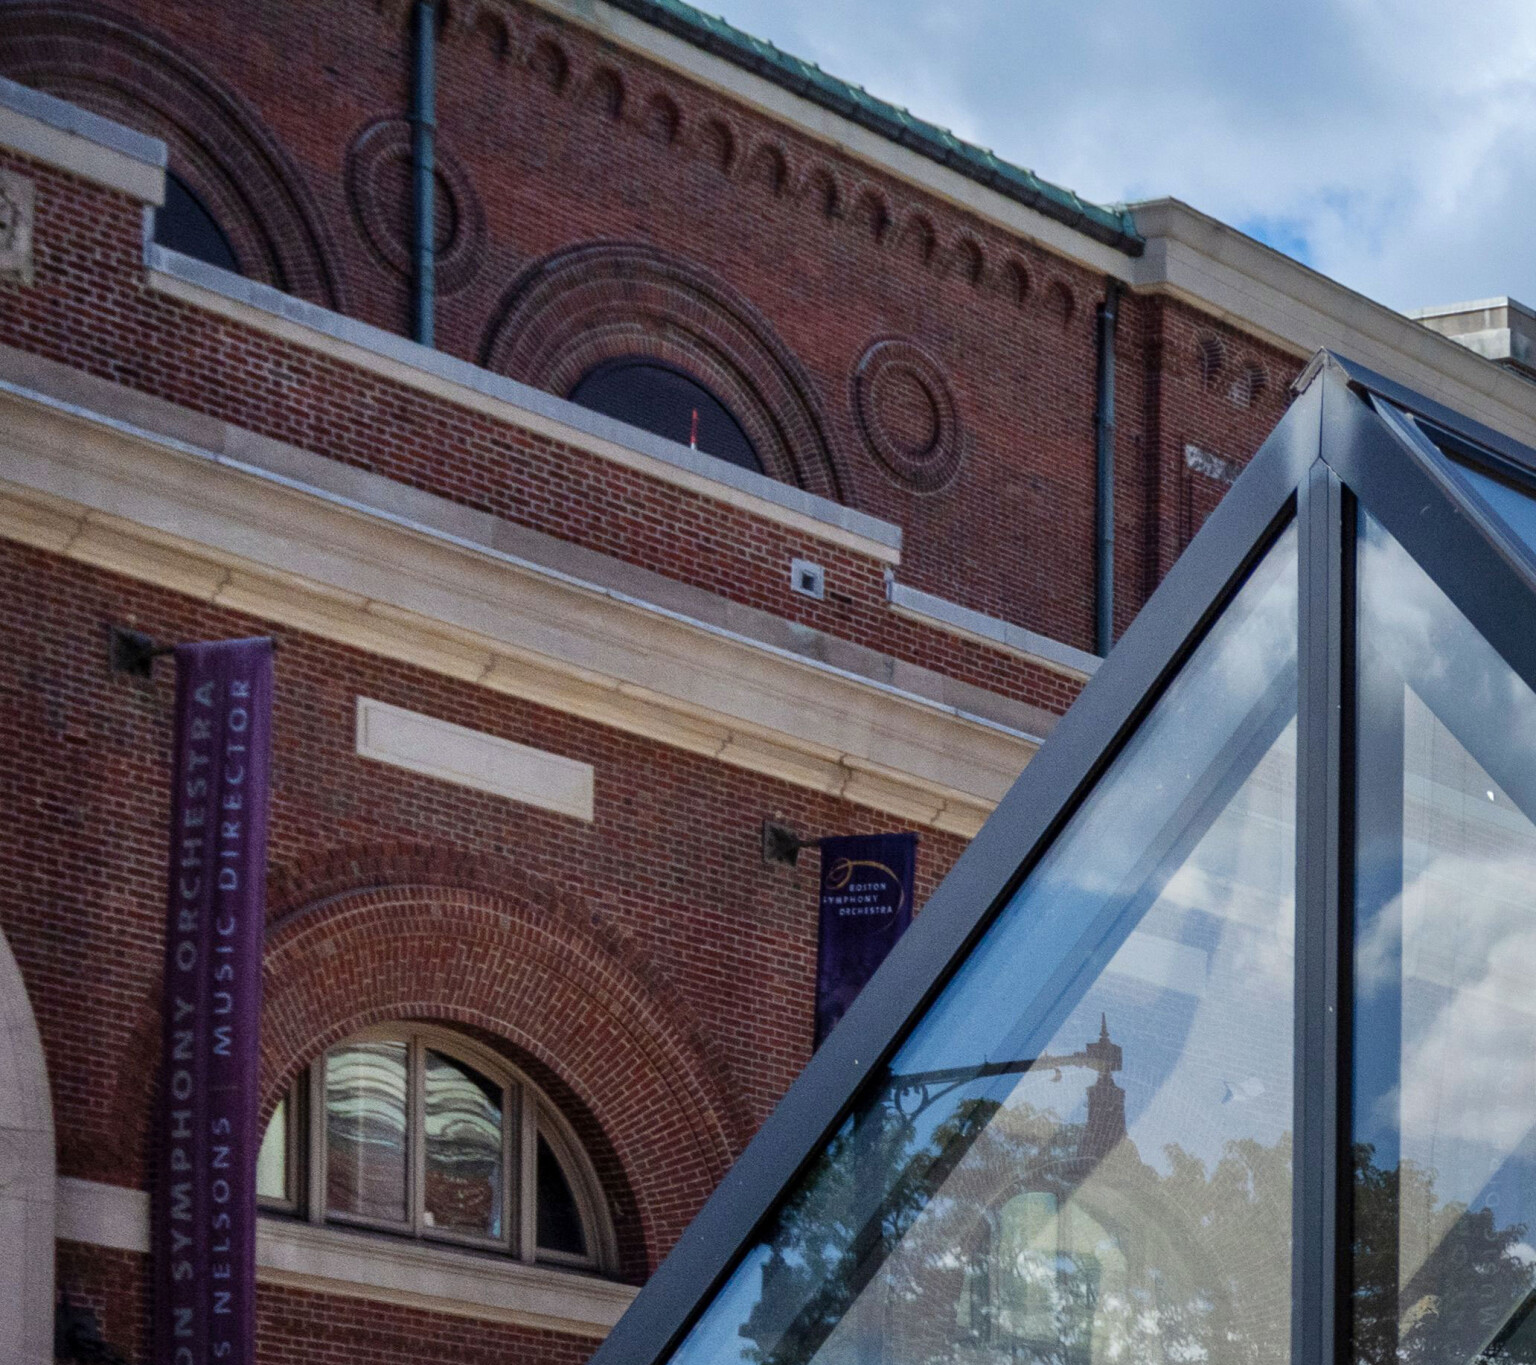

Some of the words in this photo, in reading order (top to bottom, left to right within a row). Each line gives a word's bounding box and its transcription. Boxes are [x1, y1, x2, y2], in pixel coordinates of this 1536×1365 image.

[176, 681, 214, 972] ORCHESTRA
[218, 679, 251, 891] DIRECTOR
[213, 915, 236, 1056] MUSIC
[839, 906, 893, 916] ORCHESTRA
[171, 997, 195, 1282] SYMPHONY
[213, 1116, 231, 1314] NELSONS
